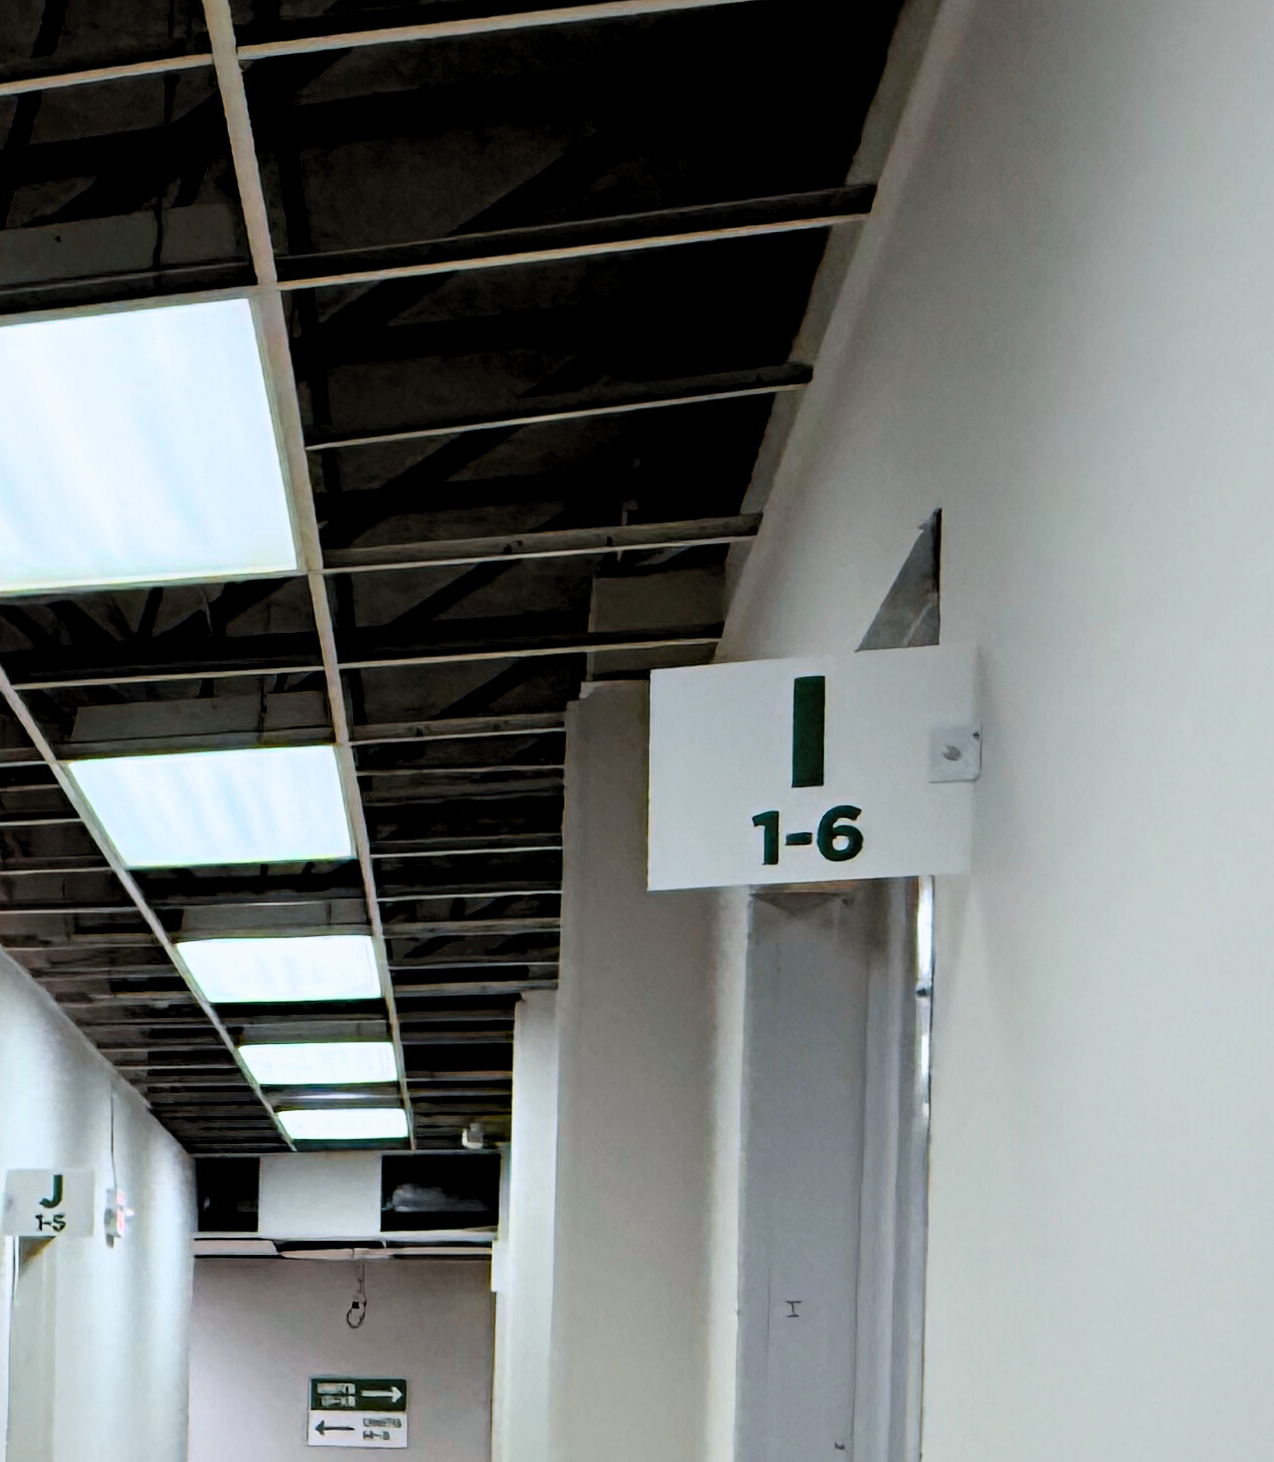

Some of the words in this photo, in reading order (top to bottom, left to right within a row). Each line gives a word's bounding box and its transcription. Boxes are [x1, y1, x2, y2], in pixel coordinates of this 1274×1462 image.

[791, 675, 826, 788] I
[751, 804, 864, 866] 1-6
[39, 1173, 64, 1209] J
[35, 1212, 67, 1233] 1-5
